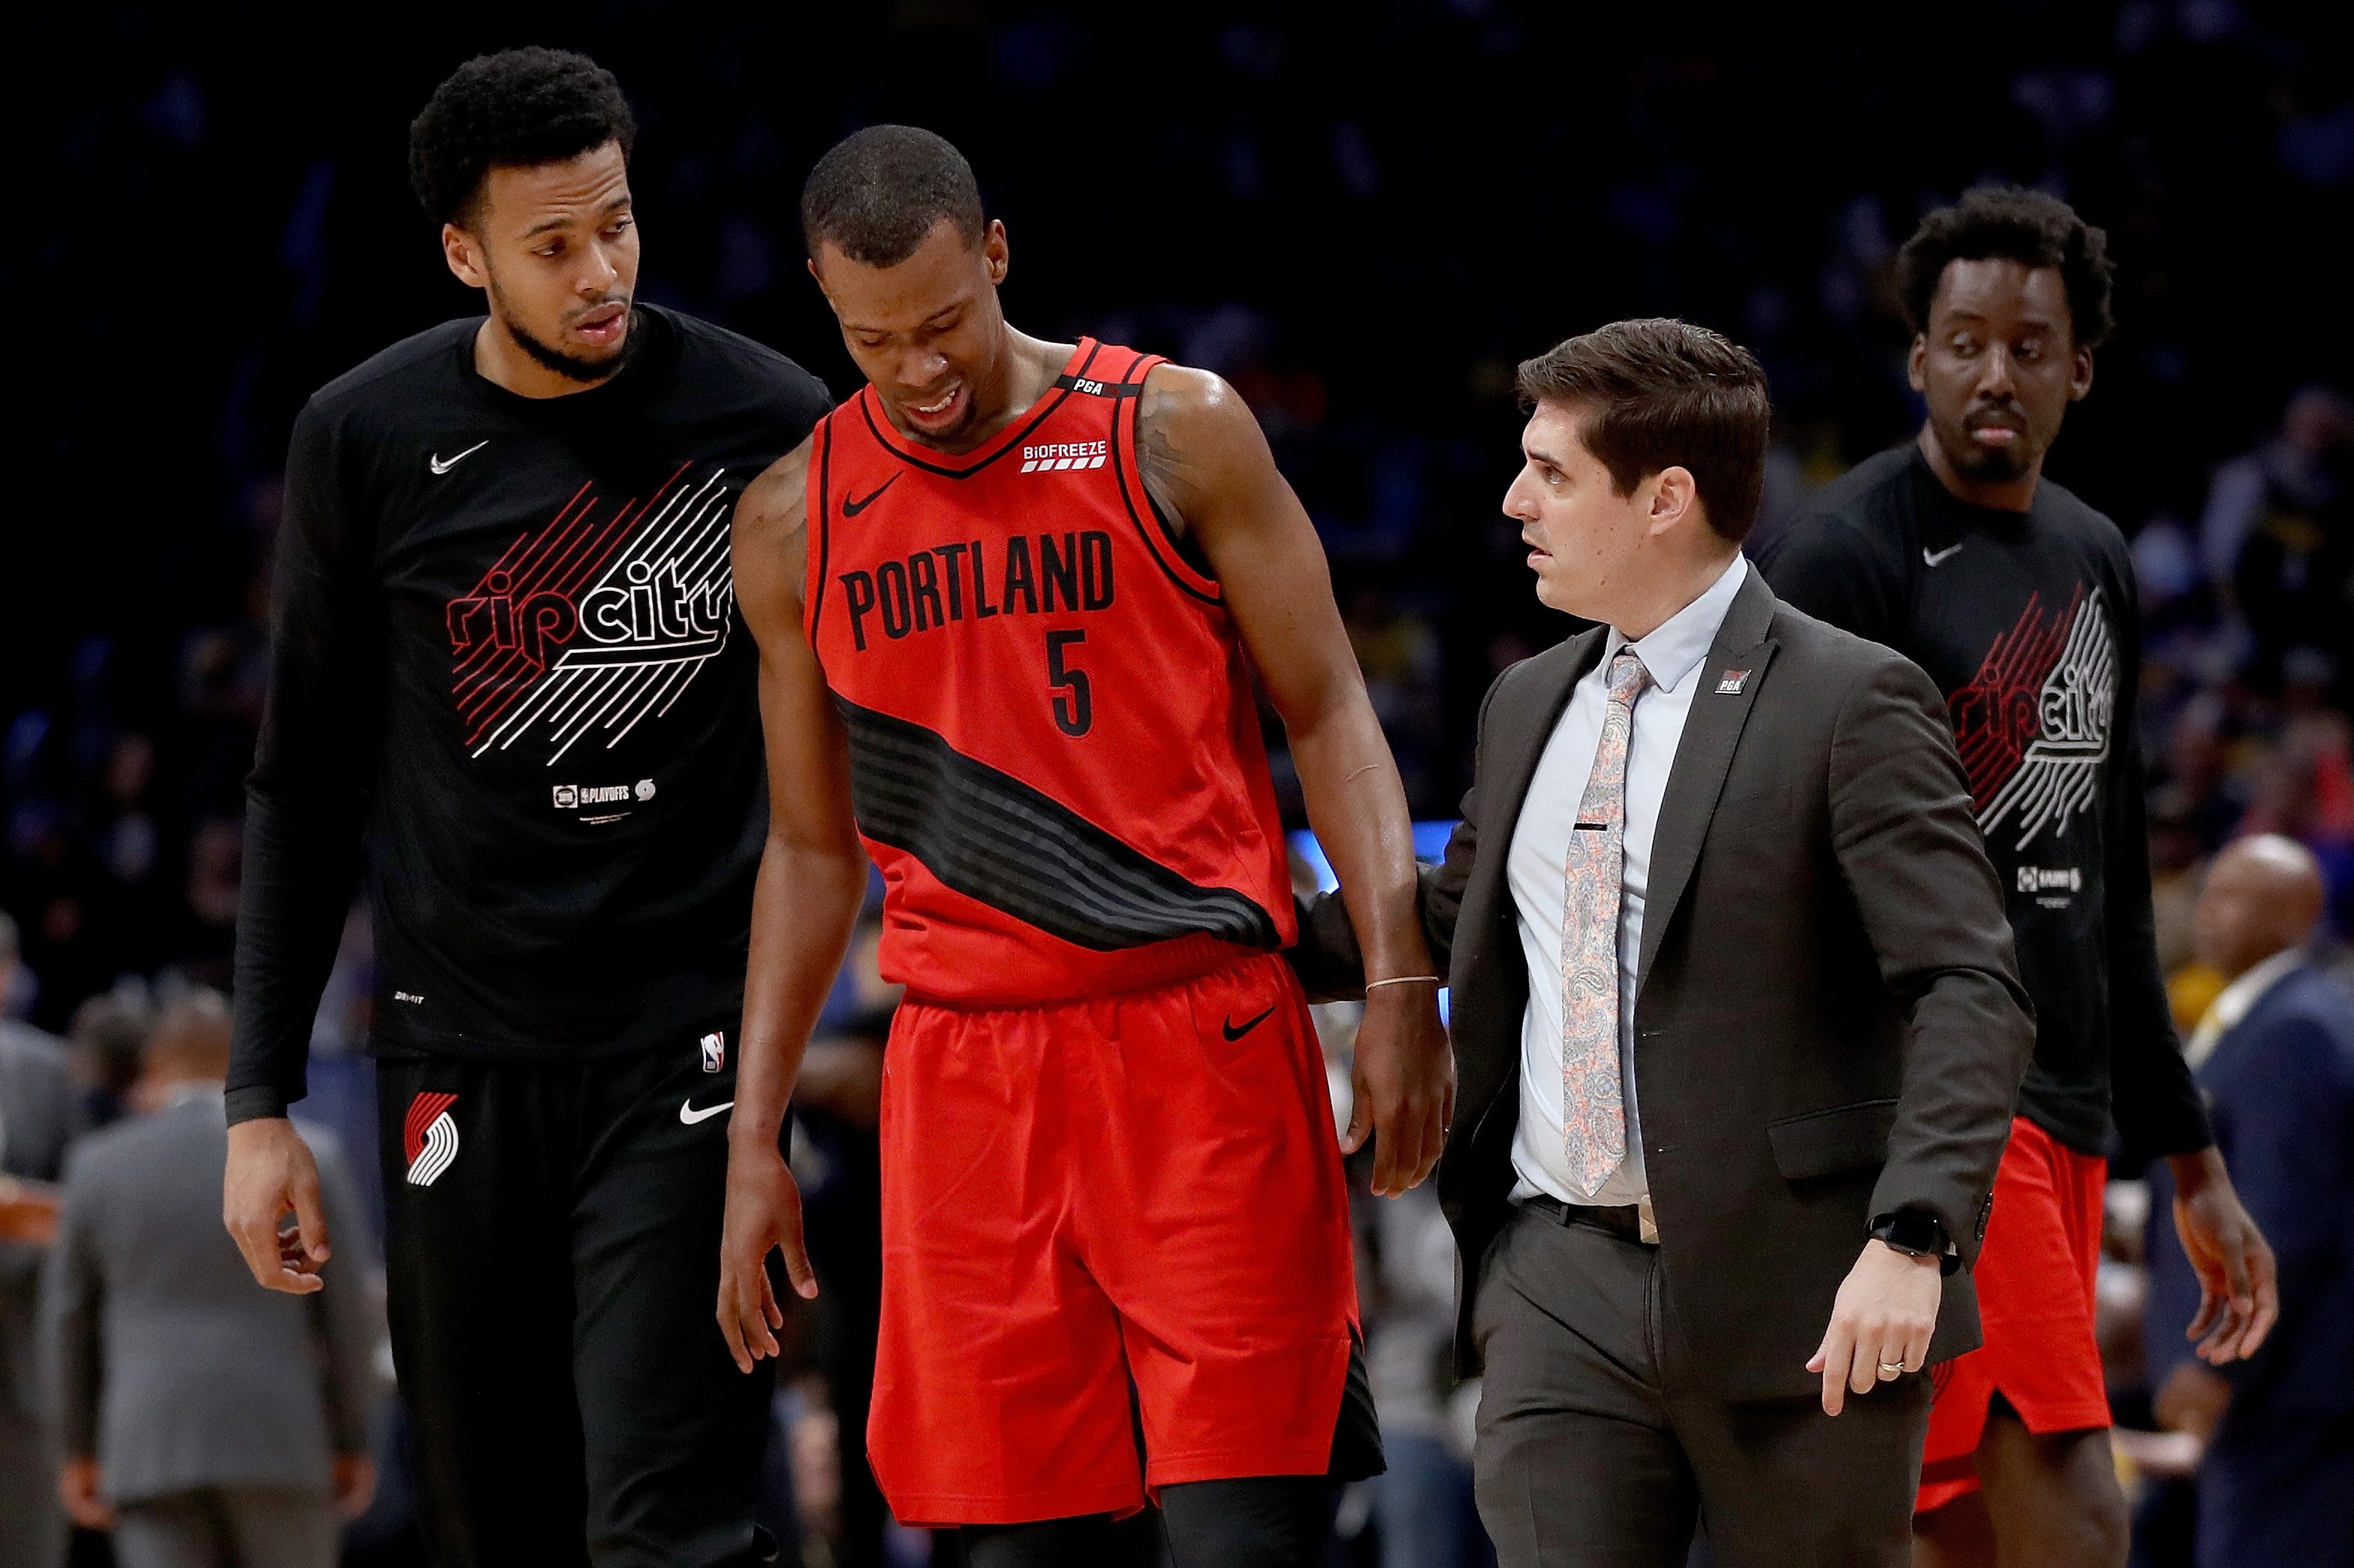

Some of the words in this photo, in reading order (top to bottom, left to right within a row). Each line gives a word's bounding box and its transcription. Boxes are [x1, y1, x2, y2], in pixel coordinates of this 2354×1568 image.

[1073, 379, 1103, 395] PGA
[447, 570, 578, 671] rip
[552, 557, 733, 670] city
[838, 530, 1115, 652] PORTLAND
[1045, 628, 1092, 737] 5
[1719, 680, 1741, 691] PGA
[589, 785, 629, 803] PLAYOFFS
